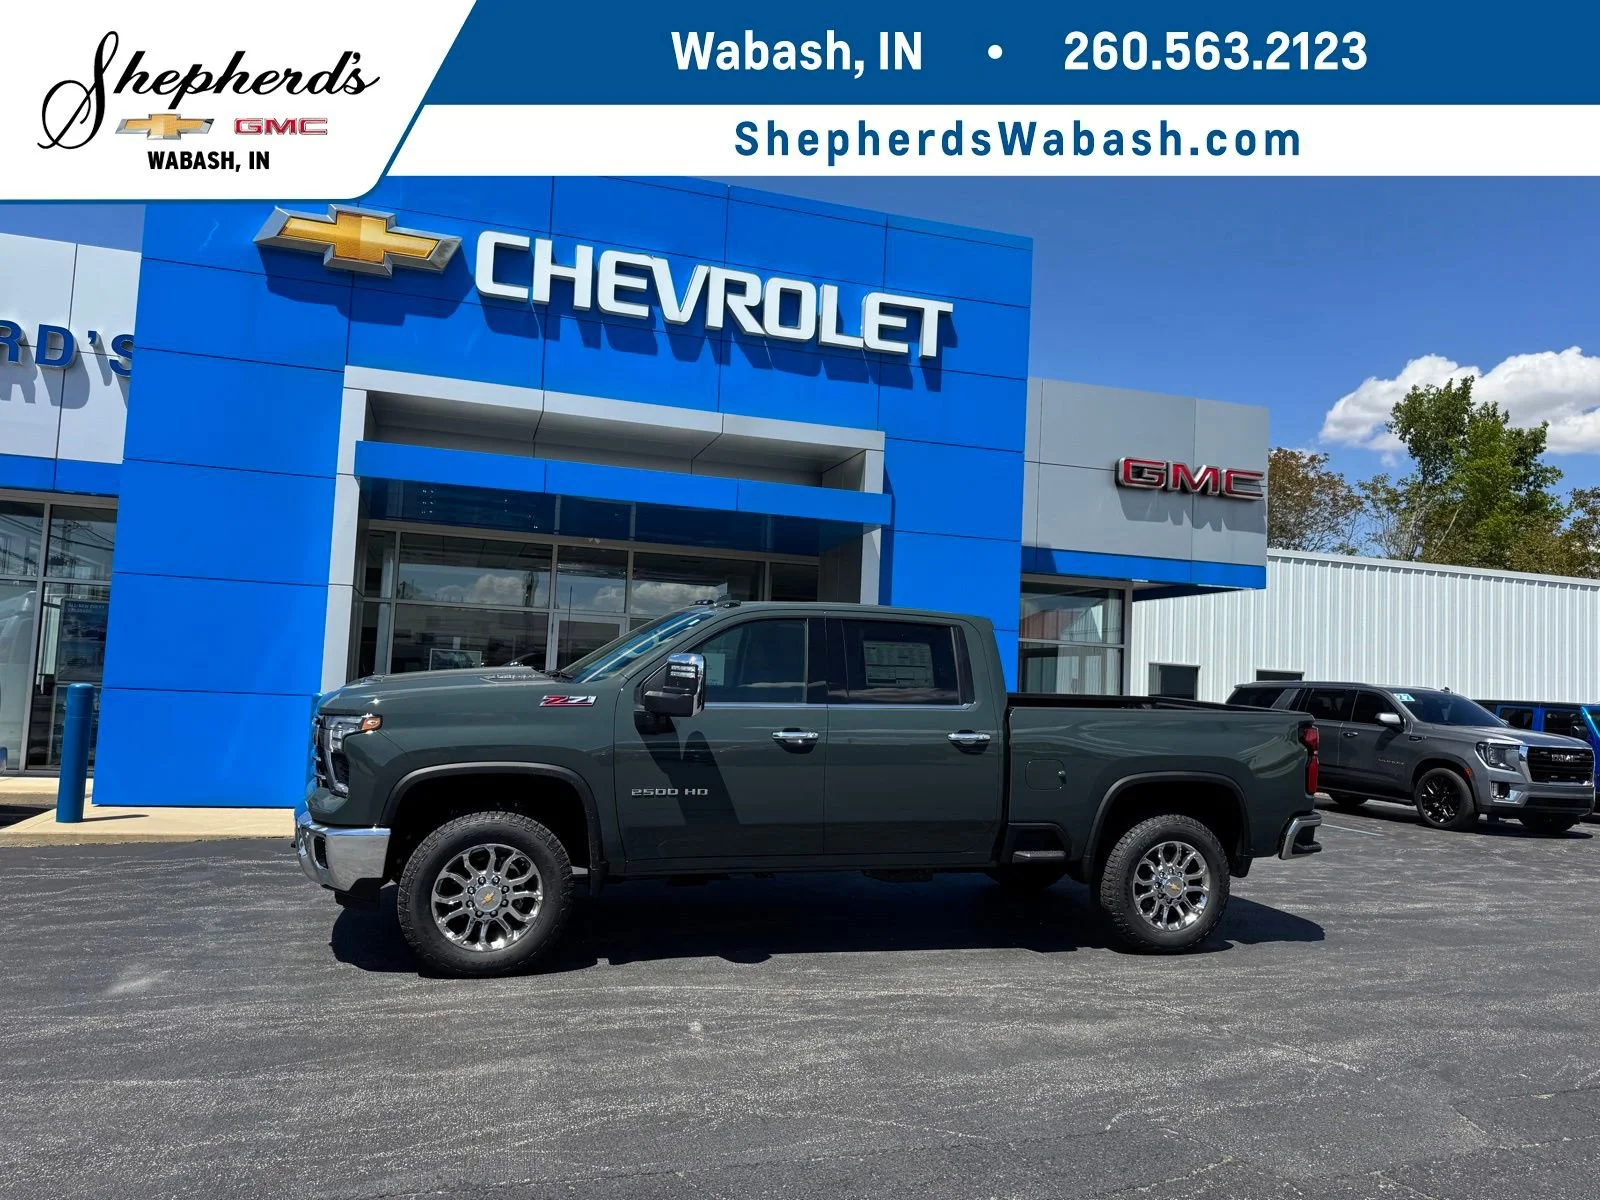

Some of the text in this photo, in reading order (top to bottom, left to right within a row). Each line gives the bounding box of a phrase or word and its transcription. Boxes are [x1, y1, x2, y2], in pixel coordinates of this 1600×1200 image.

[475, 230, 954, 358] CHEVROLET
[1117, 457, 1264, 500] GMC
[540, 695, 597, 707] Z71
[631, 788, 709, 796] 2500 HD
